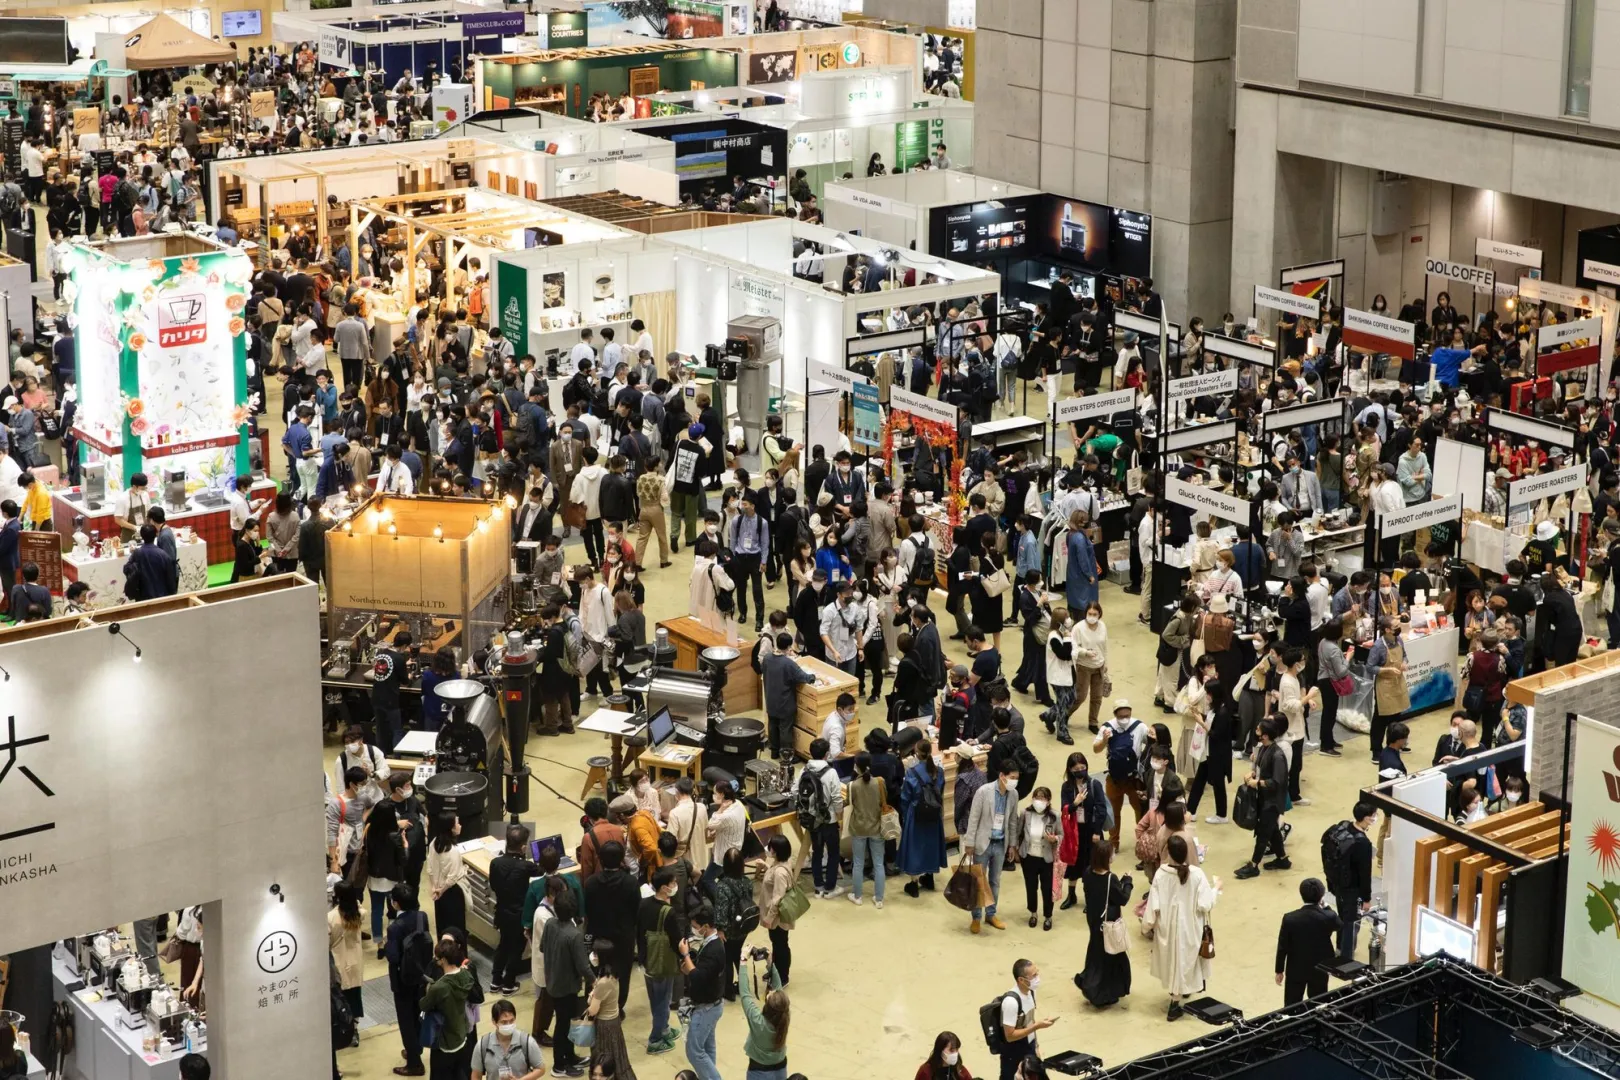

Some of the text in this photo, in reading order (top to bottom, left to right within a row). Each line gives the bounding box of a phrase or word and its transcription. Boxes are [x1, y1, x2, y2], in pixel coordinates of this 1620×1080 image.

[551, 29, 584, 38] COUNTRIES
[869, 199, 882, 207] JAPAN
[1119, 217, 1149, 230] Siphonysta
[1588, 266, 1613, 276] JUNCTION
[743, 280, 772, 299] Meister
[1257, 292, 1281, 303] NUTSTOWN
[1281, 297, 1297, 306] COFFEE
[1372, 320, 1389, 330] COFFEE
[1389, 324, 1410, 335] FACTORY
[161, 327, 206, 344] カリタ
[1183, 387, 1197, 396] Good
[1197, 384, 1219, 393] Roasters
[918, 402, 934, 412] coffee
[934, 408, 954, 418] roasters
[1061, 395, 1131, 415] SEVEN STEPS COFFEE CLUB
[171, 441, 217, 455] kalita Brew Bar
[1519, 473, 1578, 495] 27 COFFEE ROASTERS
[1178, 488, 1236, 513] Gluck Coffee Spot
[1387, 503, 1457, 527] TAPROOT coffee roasters
[349, 595, 381, 605] Northern
[1418, 660, 1431, 668] crop
[258, 988, 299, 1009] 焙煎所
